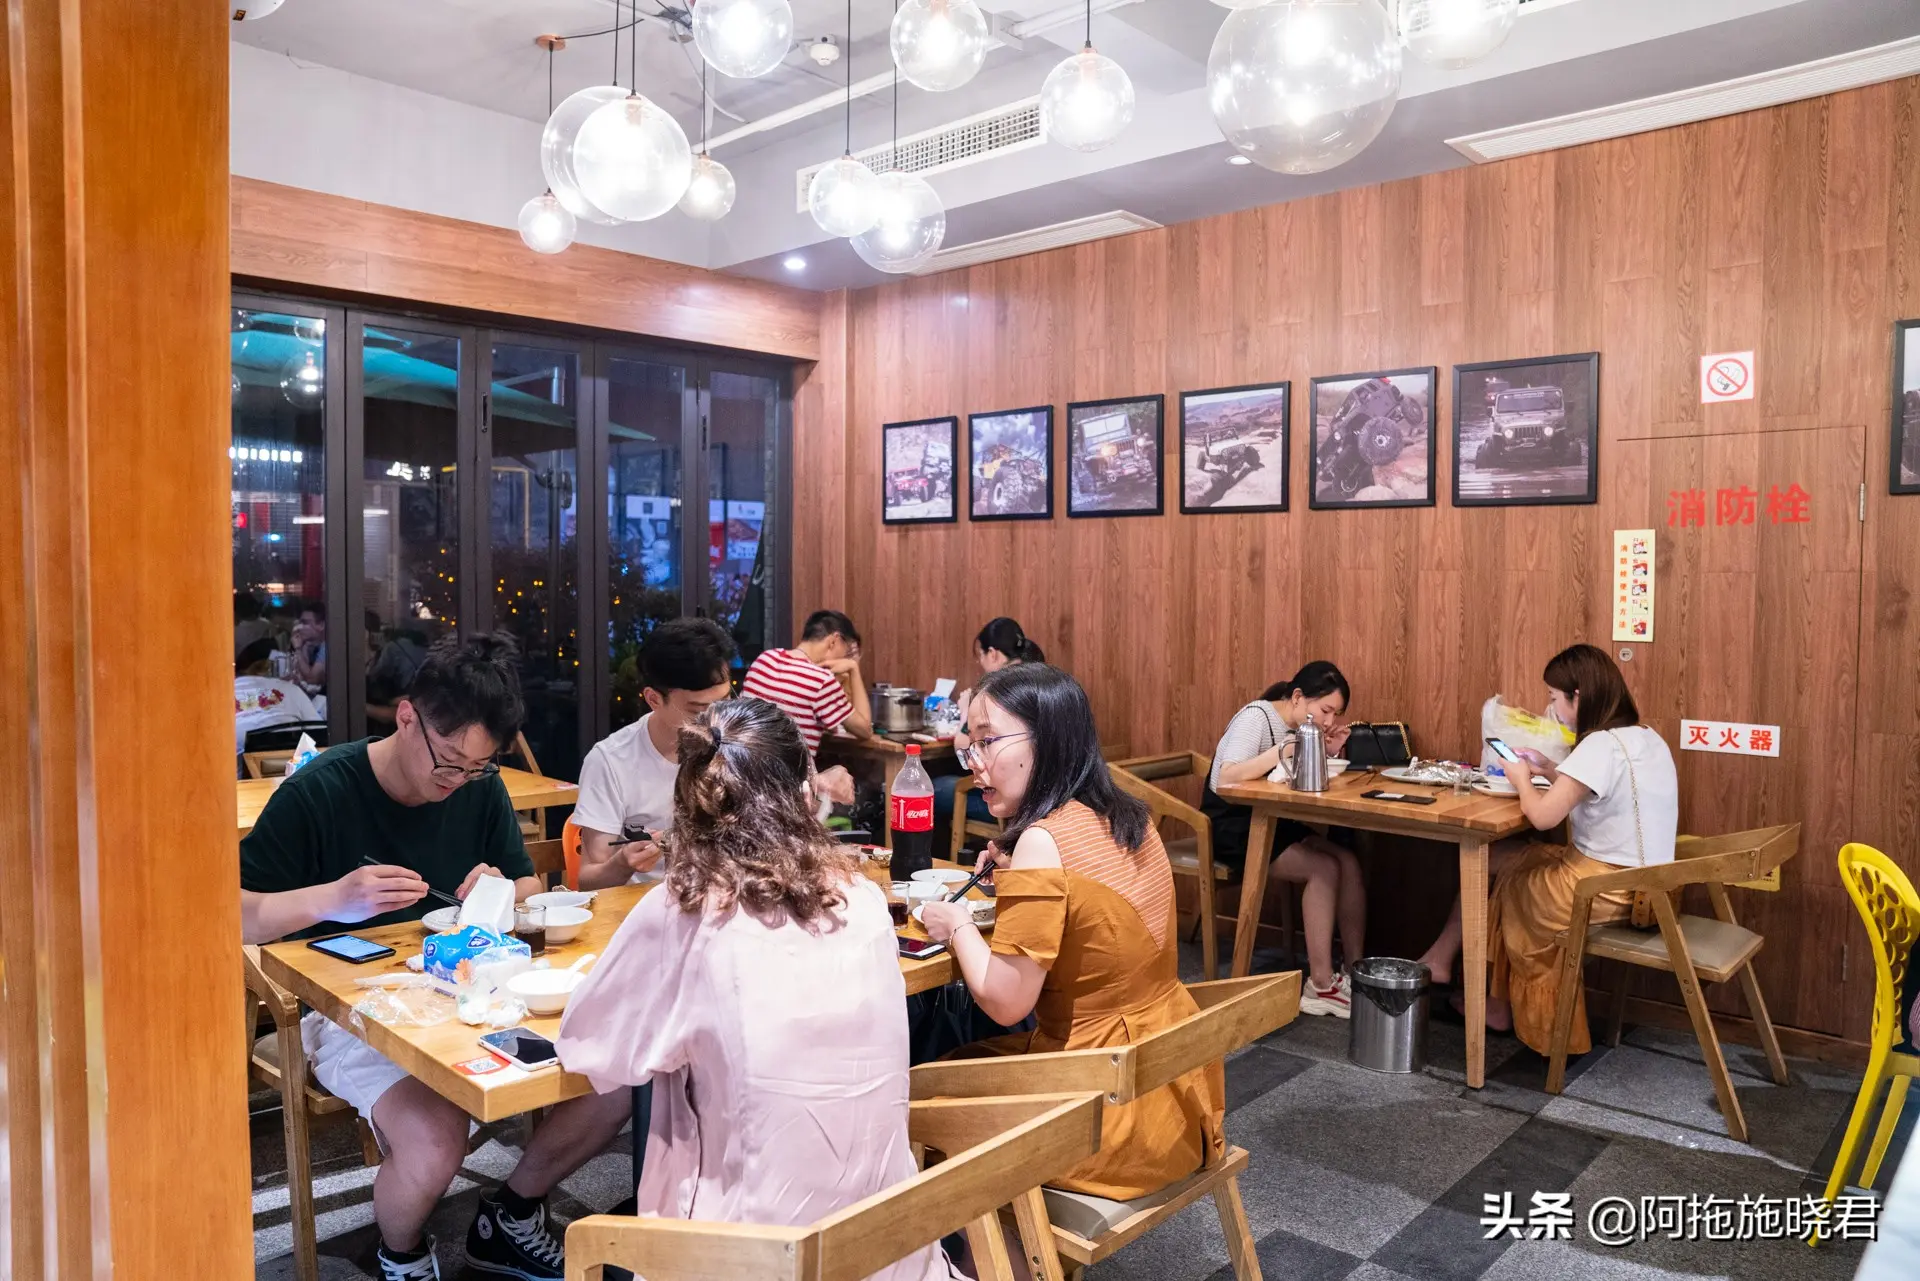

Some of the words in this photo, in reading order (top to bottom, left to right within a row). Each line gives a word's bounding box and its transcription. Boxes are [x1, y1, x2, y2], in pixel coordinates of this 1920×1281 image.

[1666, 482, 1812, 528] 消防栓
[1688, 726, 1773, 751] 灭火器
